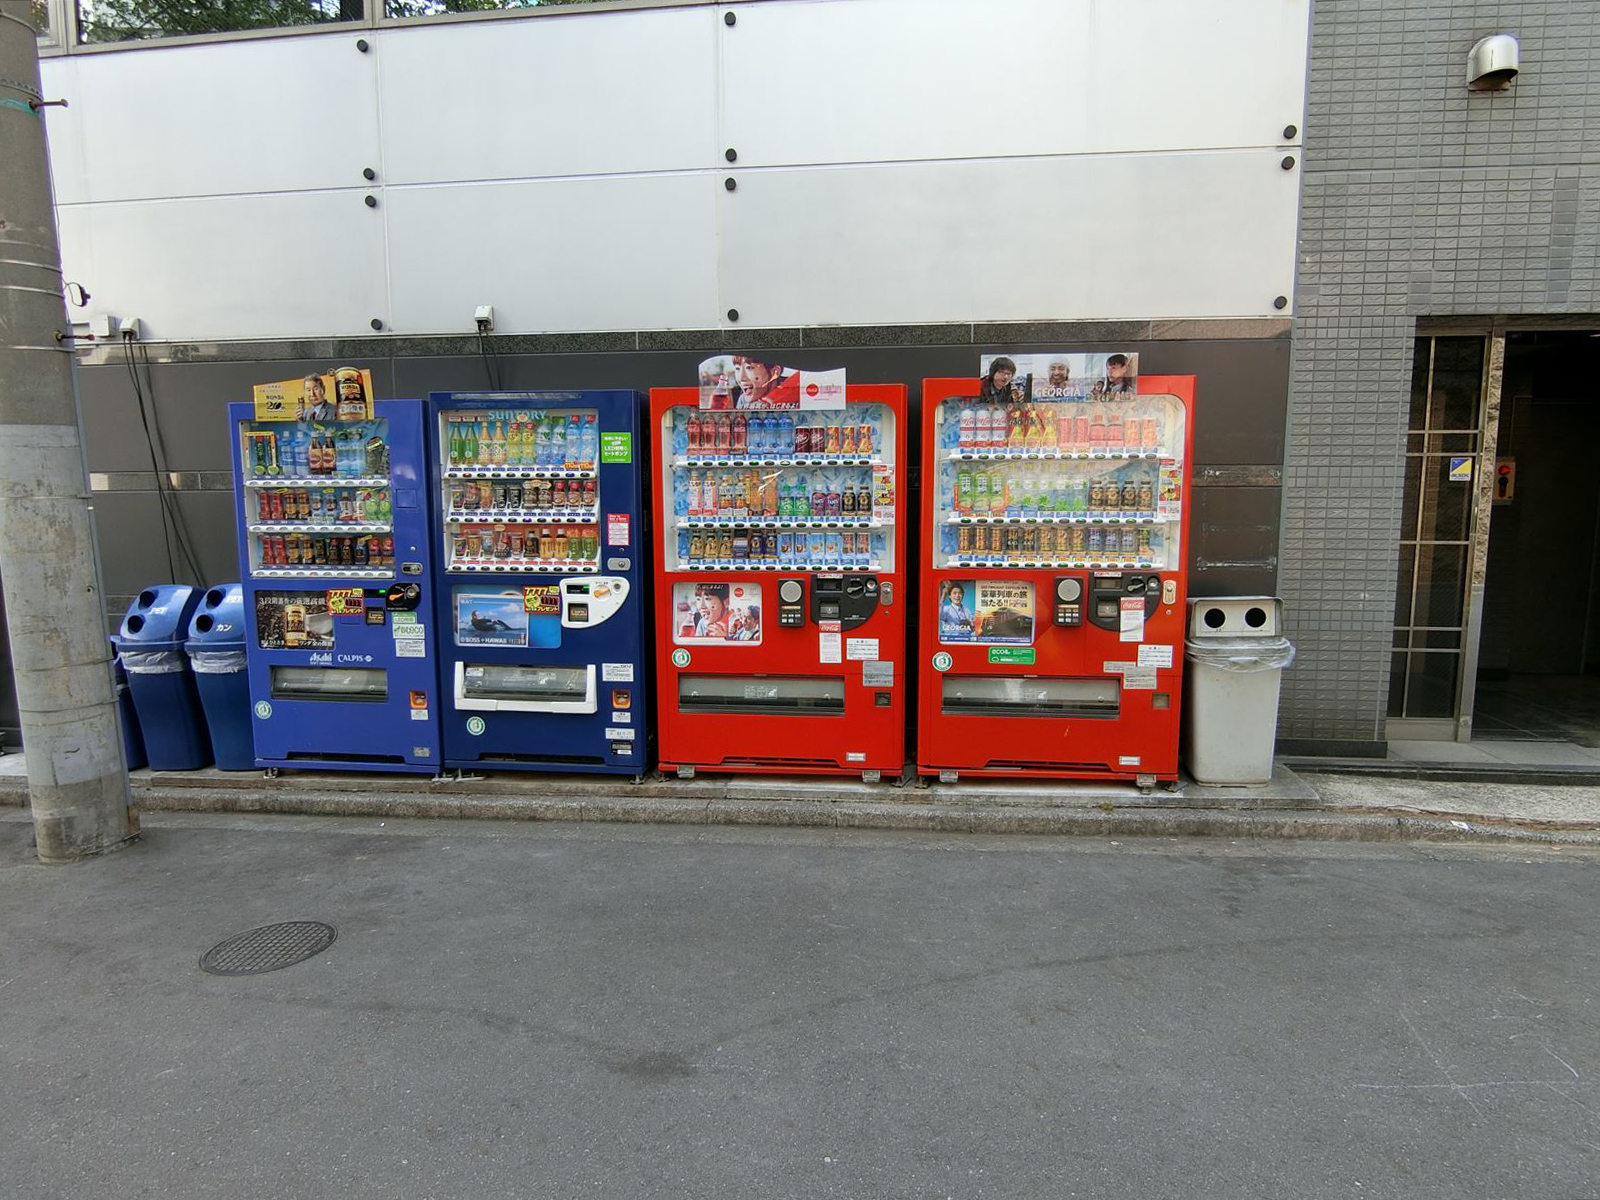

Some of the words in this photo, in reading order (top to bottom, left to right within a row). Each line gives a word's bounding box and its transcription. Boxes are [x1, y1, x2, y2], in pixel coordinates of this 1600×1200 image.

[1035, 387, 1080, 397] GEORGIA
[942, 623, 971, 631] GEORGIA
[310, 652, 332, 661] Asahi
